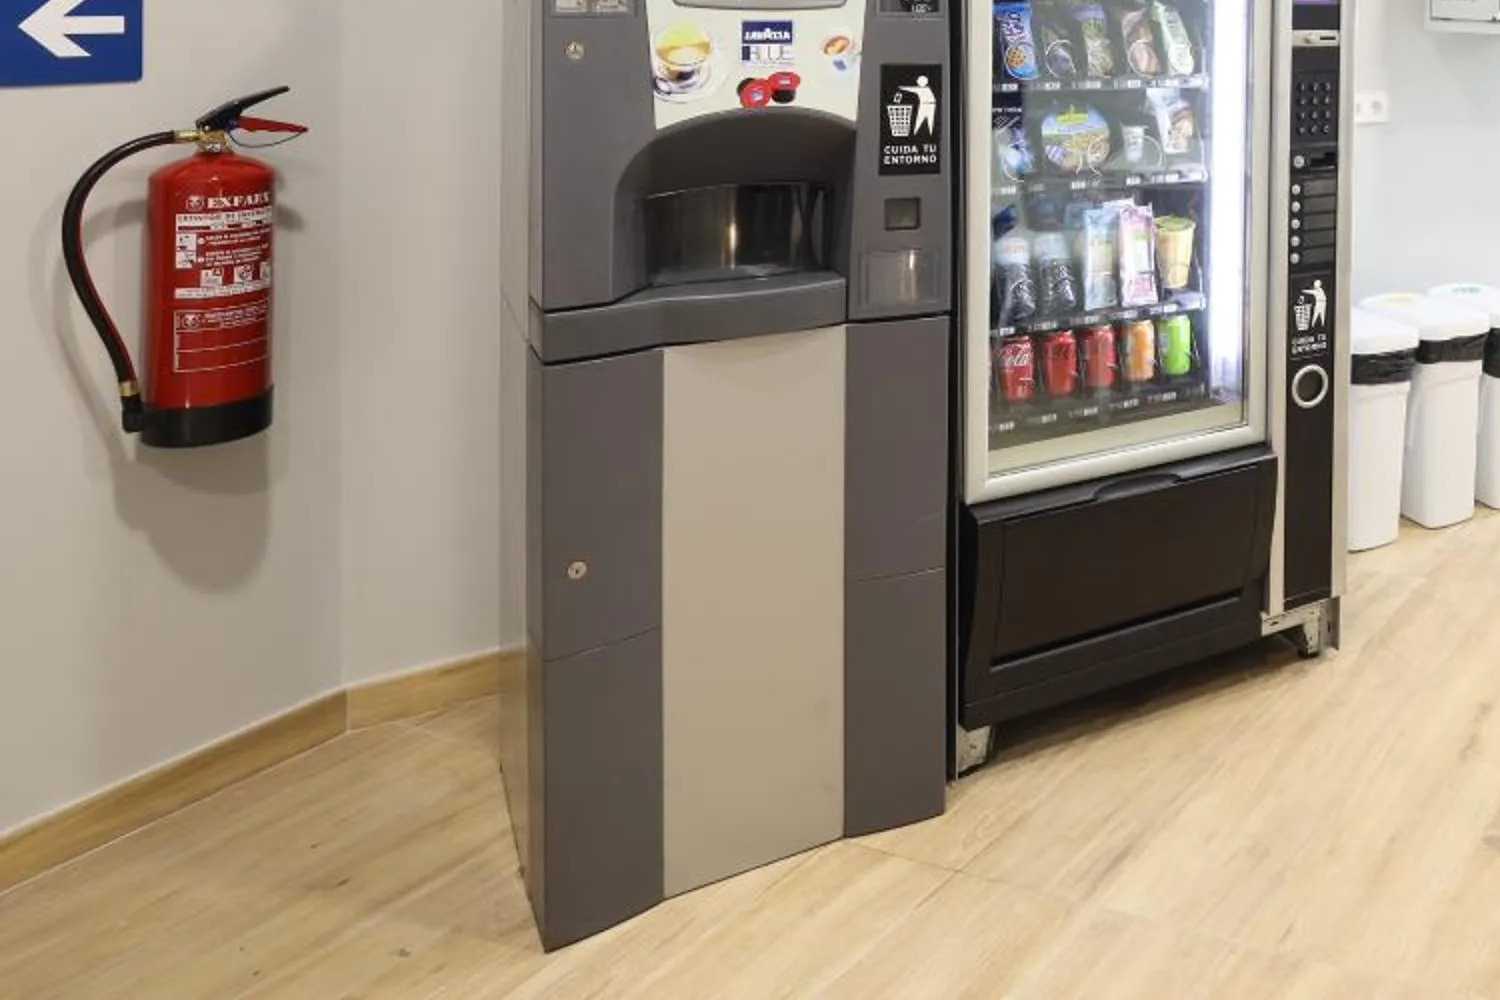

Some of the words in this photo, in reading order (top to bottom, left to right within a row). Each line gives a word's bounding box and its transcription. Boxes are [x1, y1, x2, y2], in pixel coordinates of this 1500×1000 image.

[883, 144, 919, 155] CUIDA
[923, 143, 937, 153] TU
[883, 153, 937, 165] ENTORNO
